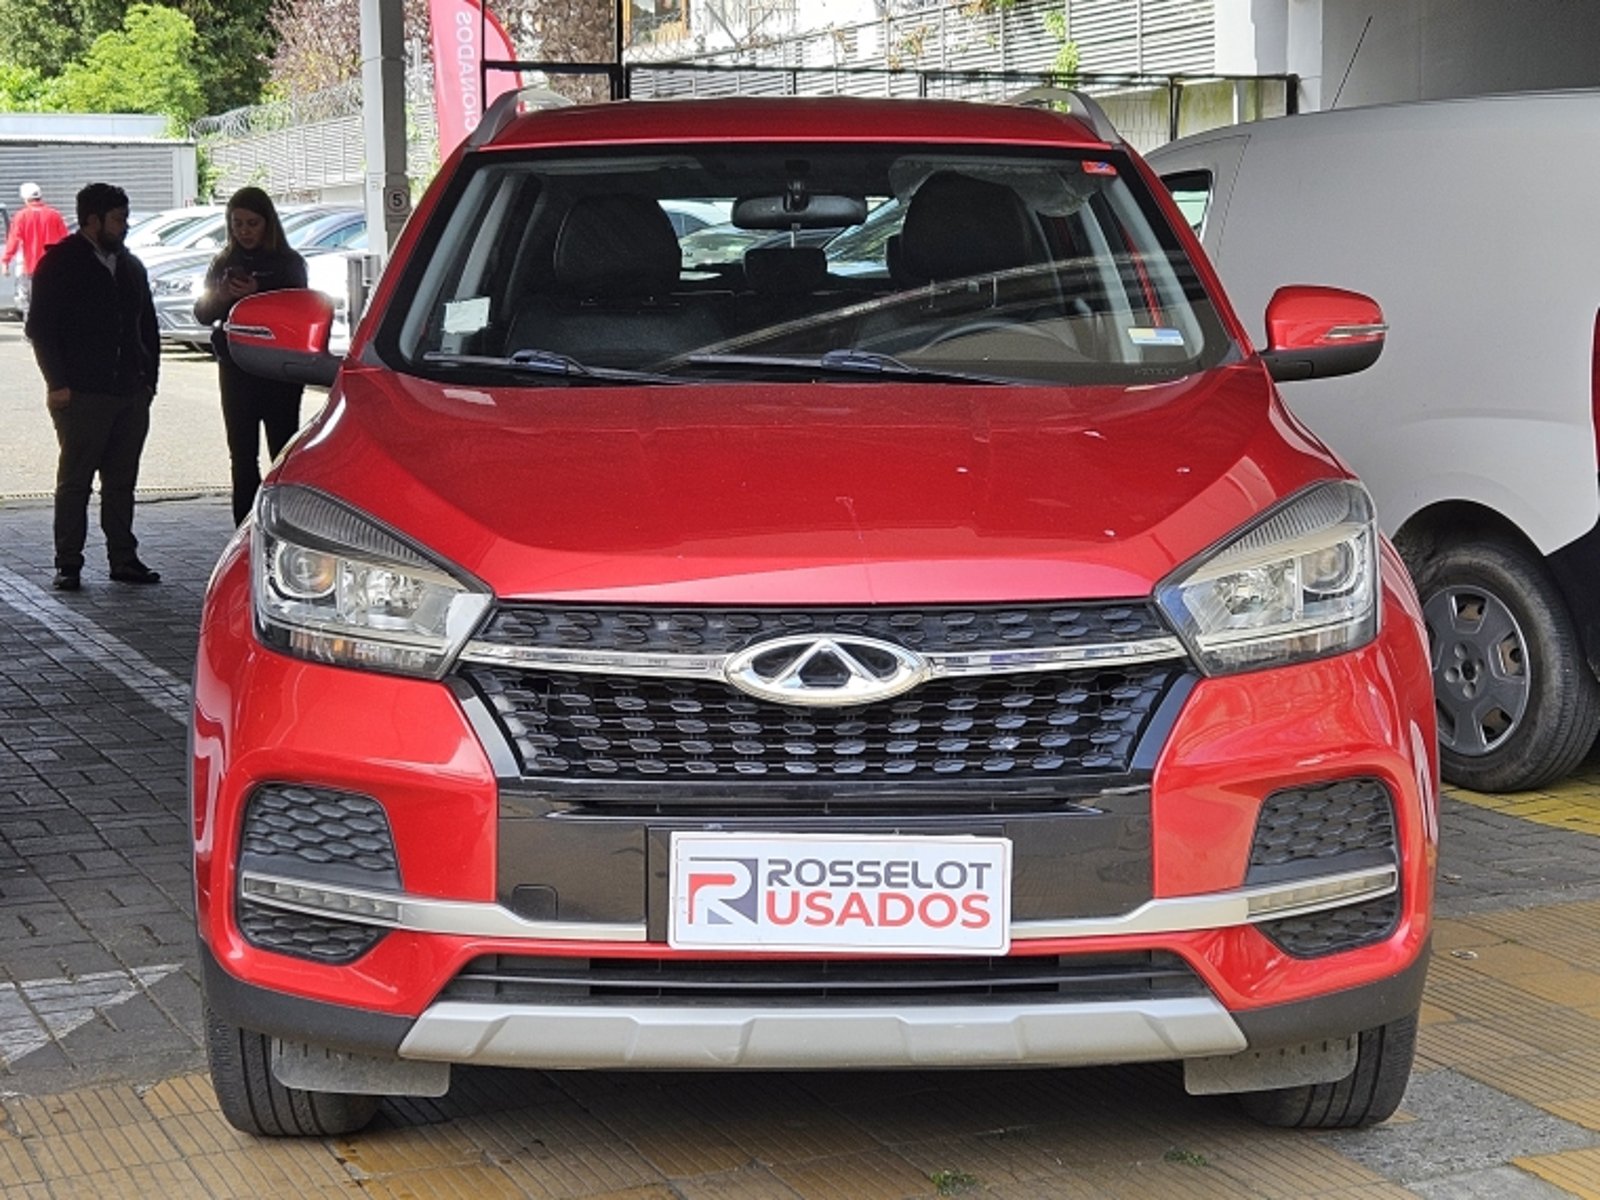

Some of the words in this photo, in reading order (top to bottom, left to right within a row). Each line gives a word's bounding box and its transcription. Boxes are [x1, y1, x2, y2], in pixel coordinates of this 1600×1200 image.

[393, 193, 403, 207] 5
[767, 858, 992, 890] ROSSELOT
[766, 890, 991, 929] USADOS
